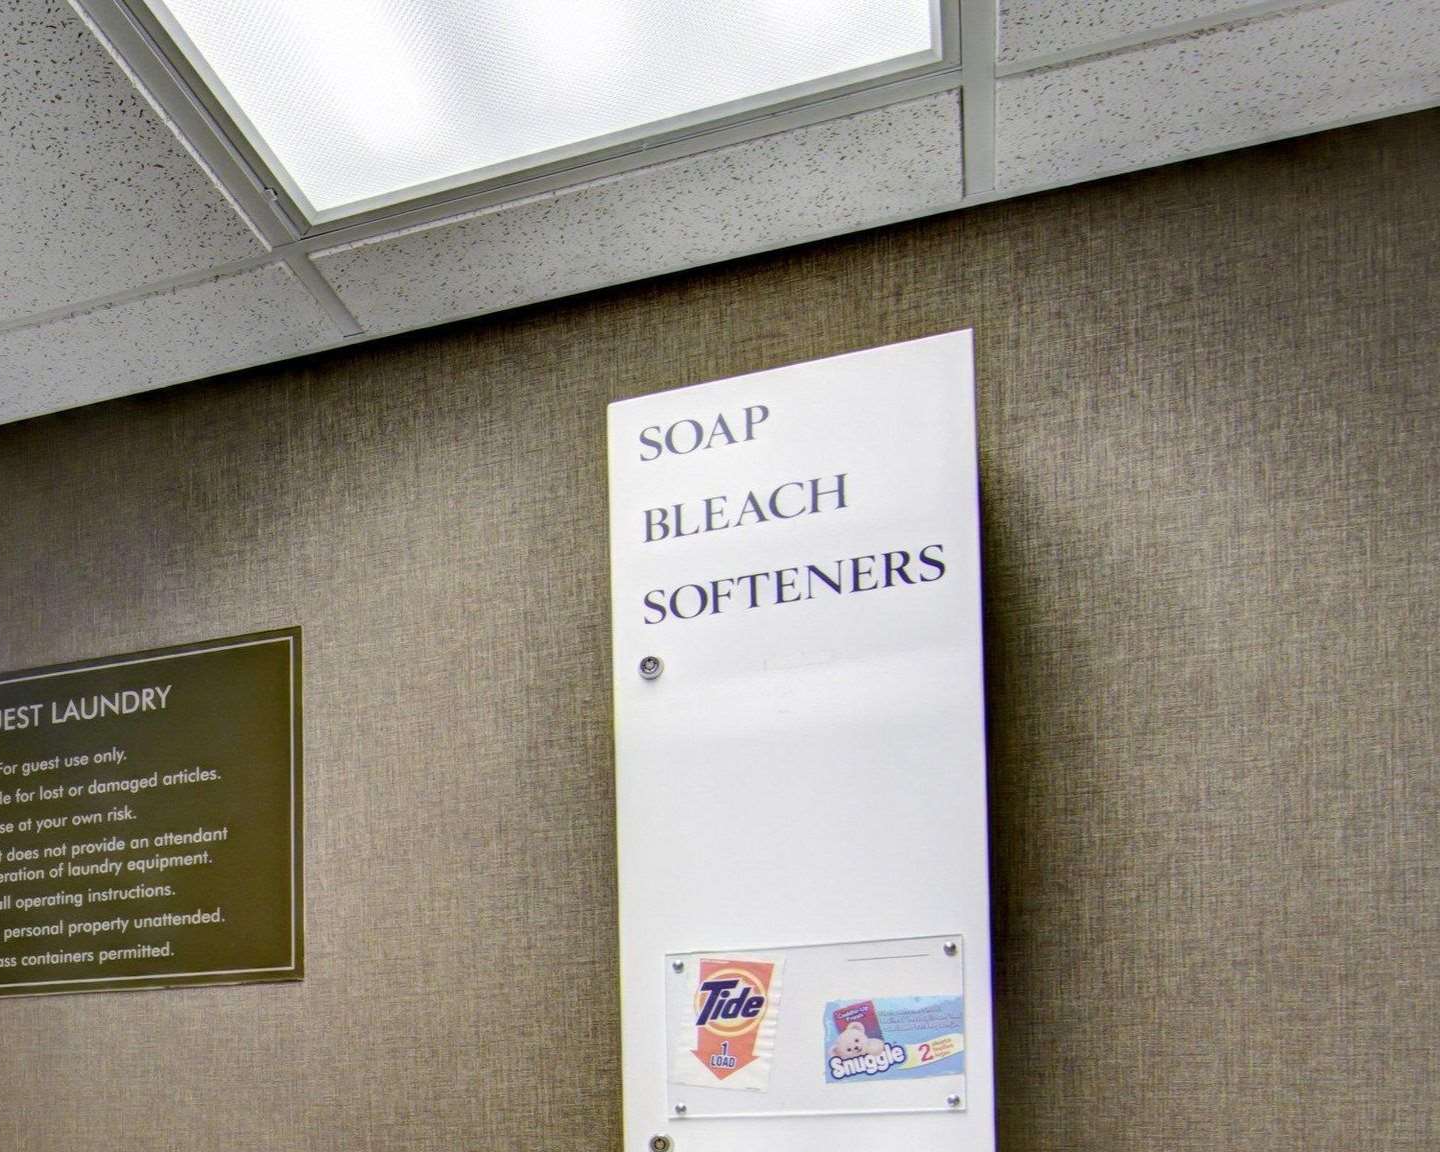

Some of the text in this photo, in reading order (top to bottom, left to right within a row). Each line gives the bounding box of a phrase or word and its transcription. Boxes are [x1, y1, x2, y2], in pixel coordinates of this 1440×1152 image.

[639, 405, 769, 462] SOAP
[644, 473, 848, 543] BLEACH
[644, 544, 946, 624] SOFTENERS
[51, 685, 172, 724] LAUNDRY
[22, 756, 60, 778] guest
[64, 753, 89, 769] use
[94, 747, 127, 769] only.
[16, 787, 35, 803] for
[39, 785, 63, 801] lost
[69, 784, 84, 797] or
[88, 773, 157, 796] damaged
[163, 767, 222, 786] articles.
[19, 818, 33, 832] at
[37, 813, 67, 834] your
[72, 812, 102, 826] own
[107, 806, 136, 822] risk.
[7, 845, 39, 861] does
[44, 841, 66, 858] not
[71, 837, 125, 858] provide
[130, 834, 149, 849] an
[154, 827, 228, 847] attendant
[49, 863, 63, 879] of
[68, 857, 122, 878] laundry
[127, 850, 213, 874] equipment.
[16, 891, 83, 913] operating
[88, 883, 176, 904] instructions.
[4, 921, 63, 945] personal
[69, 916, 128, 938] property
[134, 908, 225, 929] unattended.
[22, 946, 94, 967] containers
[99, 942, 175, 965] permitted.
[696, 979, 765, 1025] Tide
[712, 1056, 736, 1068] LOAD
[721, 1042, 728, 1056] 1
[829, 1042, 906, 1079] Snuggle
[918, 1043, 934, 1062] 2
